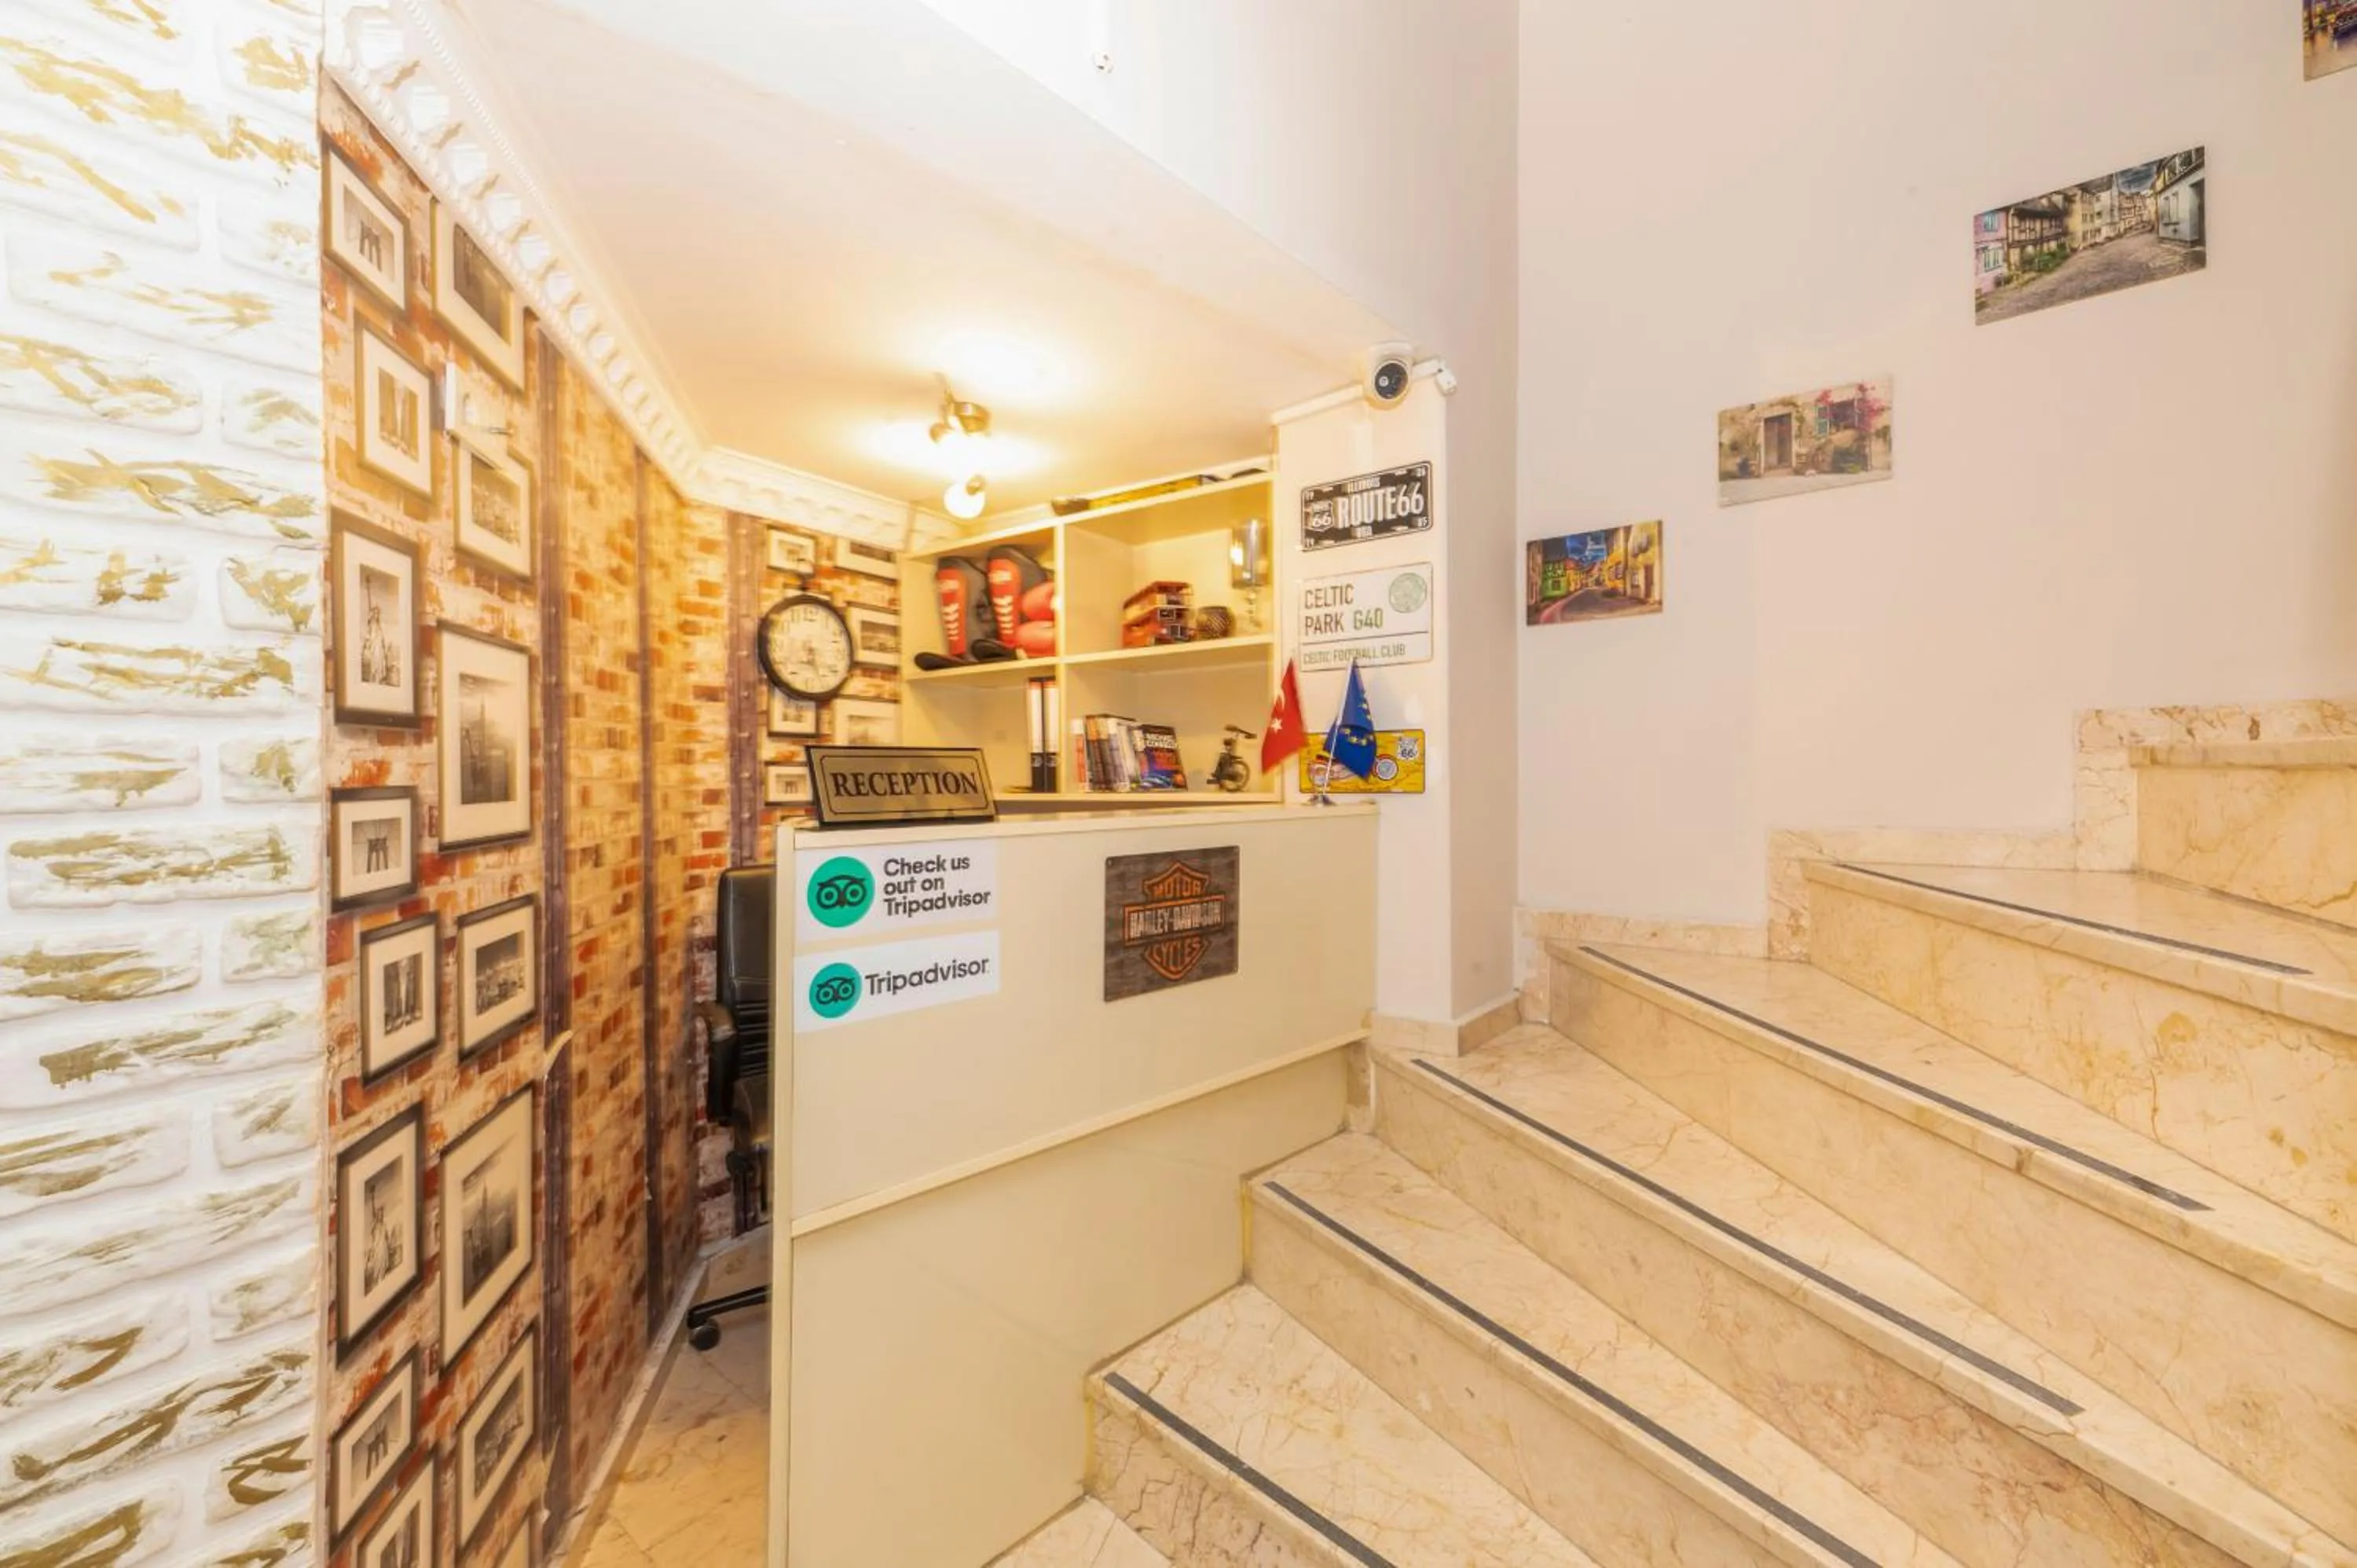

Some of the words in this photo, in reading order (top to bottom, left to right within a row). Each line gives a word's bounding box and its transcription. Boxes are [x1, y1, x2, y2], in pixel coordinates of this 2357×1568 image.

[1305, 584, 1354, 610] CELTIC
[1305, 612, 1344, 636] PARK
[1354, 607, 1383, 630] G40
[1380, 643, 1406, 658] CLUB
[832, 771, 979, 797] RECEPTION
[884, 855, 946, 877] Check
[951, 856, 970, 871] us
[883, 877, 916, 896] out
[921, 877, 944, 892] on
[883, 889, 992, 918] Tripadvisor
[865, 957, 989, 996] Tripadvisor
